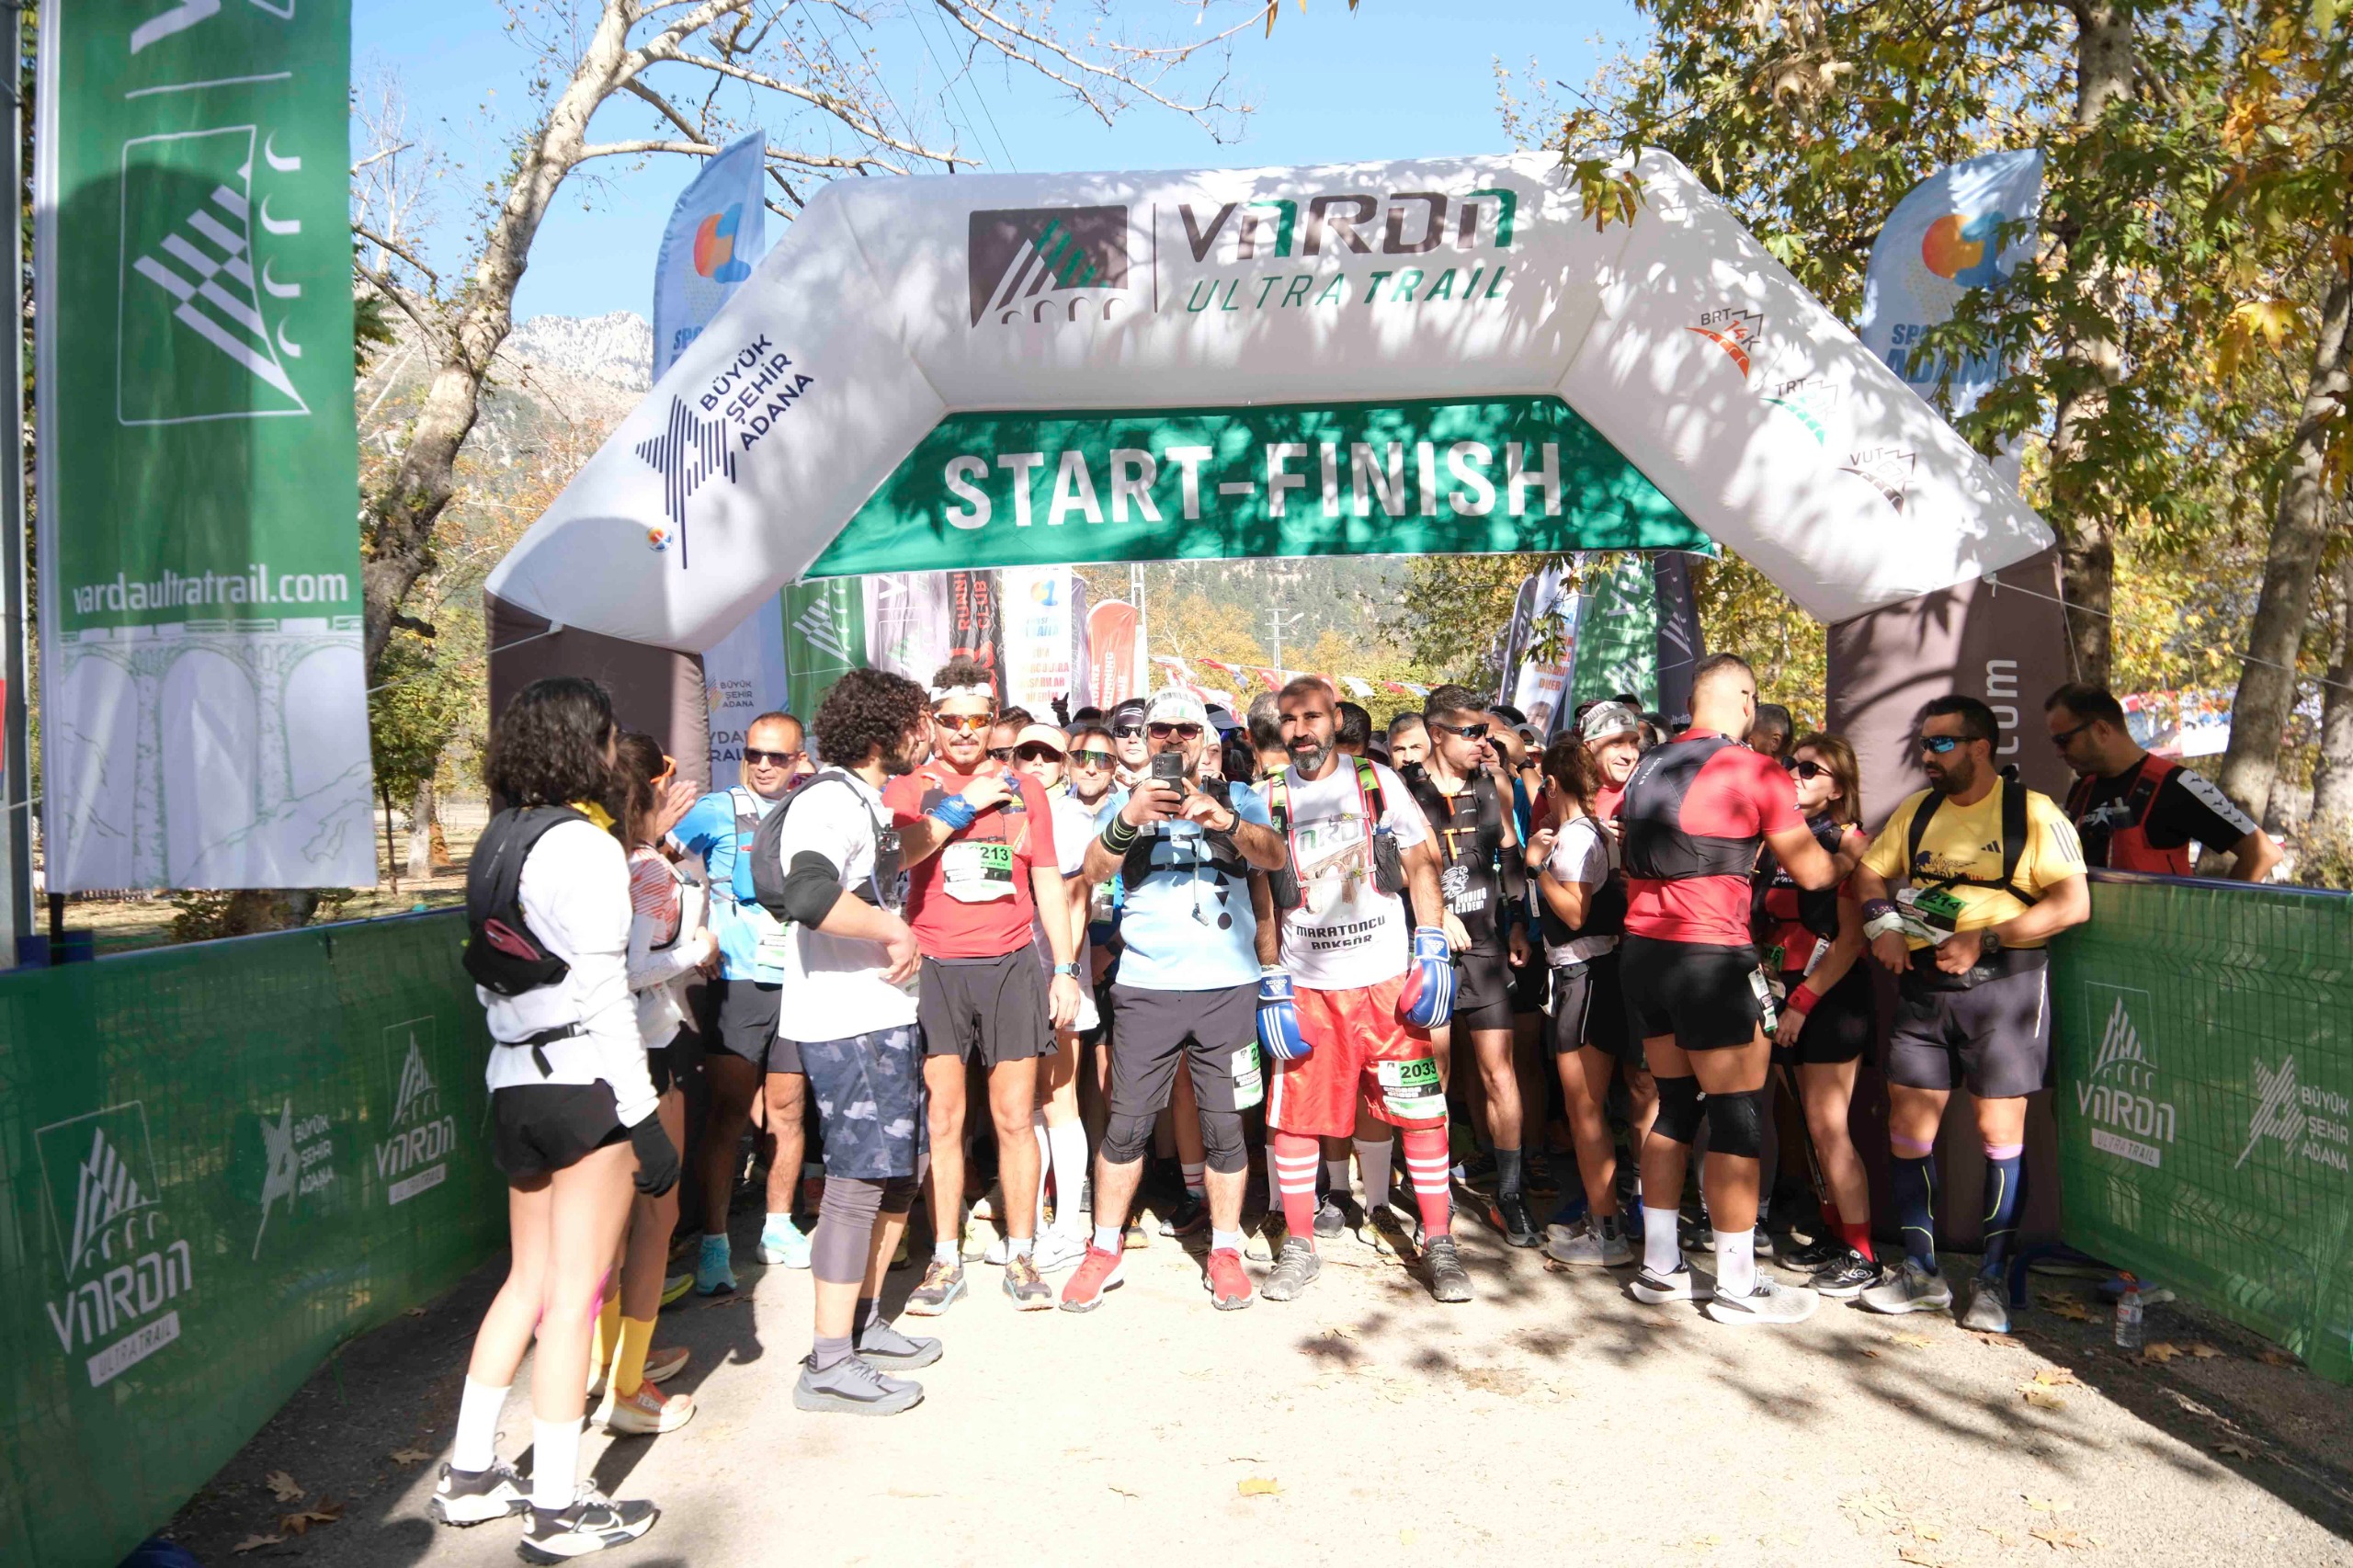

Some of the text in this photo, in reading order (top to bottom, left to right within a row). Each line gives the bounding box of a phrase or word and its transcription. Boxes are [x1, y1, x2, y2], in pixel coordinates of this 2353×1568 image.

[1187, 267, 1506, 312] ULTRA TRAIL
[1700, 308, 1732, 326] BRT
[1724, 320, 1761, 352] 14K
[699, 334, 772, 412] BÜYÜK
[1775, 378, 1807, 397] TRT
[725, 353, 792, 425] ŞEHİR
[740, 373, 814, 450] ADANA
[1849, 448, 1883, 466] VUT
[944, 442, 1563, 530] START-FINISH
[73, 563, 349, 614] vardaultratrail.com
[721, 680, 752, 689] BÜYÜK
[725, 690, 753, 700] ŞEHİR
[1296, 915, 1386, 937] MARATONCU
[1401, 1061, 1437, 1079] 2033
[2302, 1085, 2349, 1118] BÜYÜK
[2308, 1115, 2349, 1145] ŞEHİR
[2097, 1133, 2154, 1162] ULTRA TRAIL
[2302, 1140, 2349, 1173] ADANA
